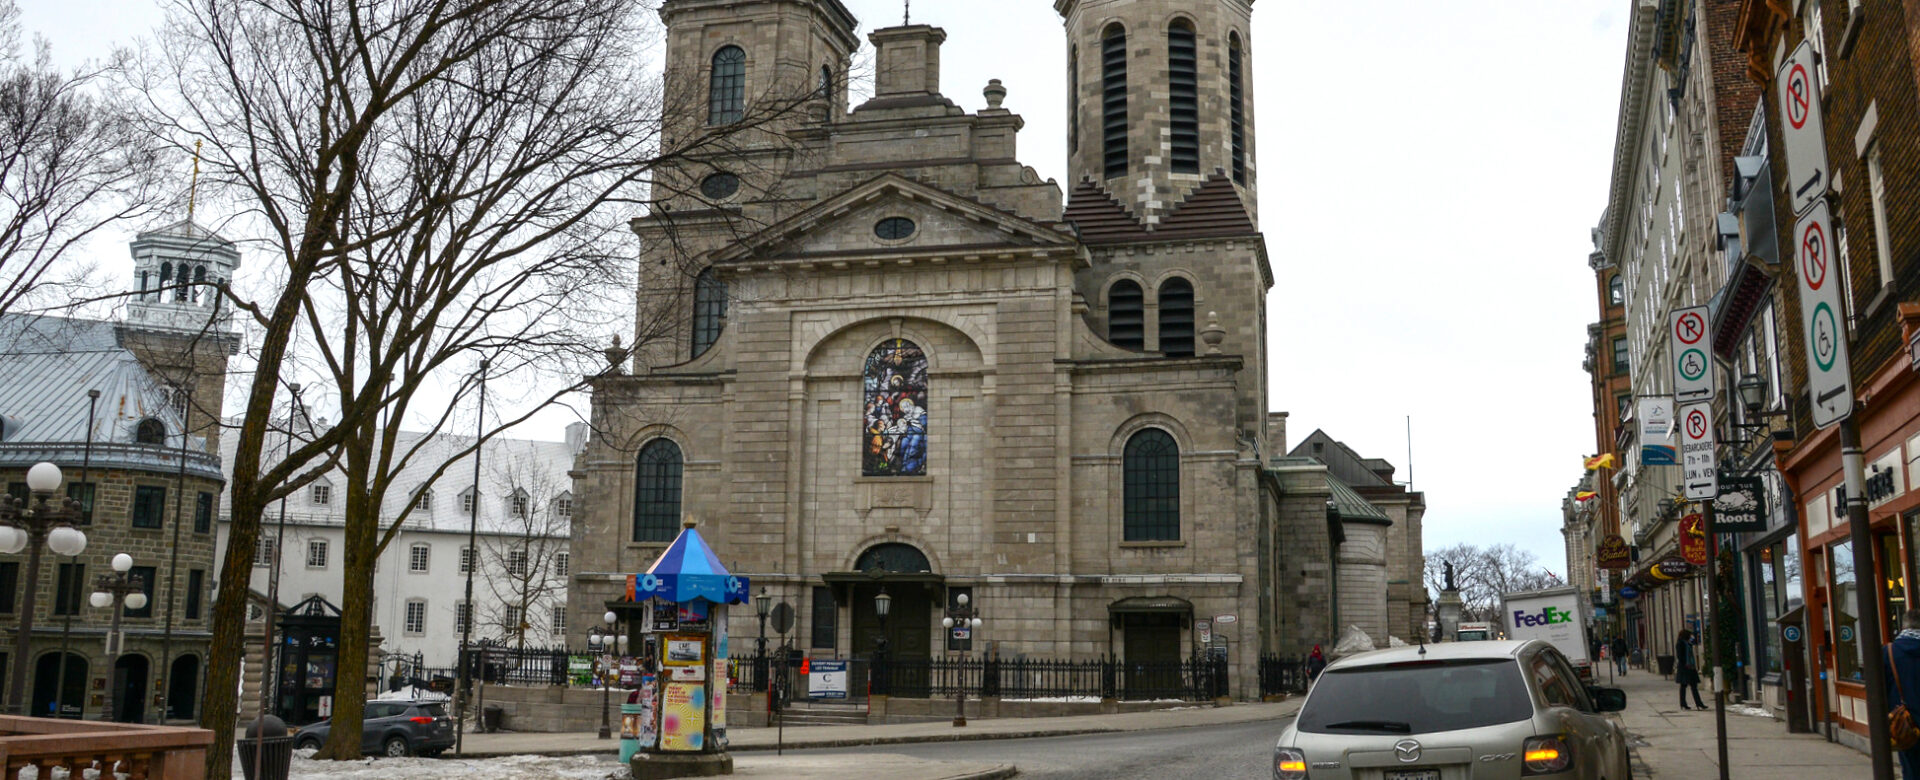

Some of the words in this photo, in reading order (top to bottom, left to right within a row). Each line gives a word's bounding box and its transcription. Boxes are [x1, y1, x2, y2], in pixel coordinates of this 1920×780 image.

[1687, 455, 1696, 465] 7h
[1685, 470, 1697, 480] LUN
[1702, 467, 1715, 478] VEN
[1715, 513, 1757, 523] Roots
[1514, 606, 1572, 628] FedEx
